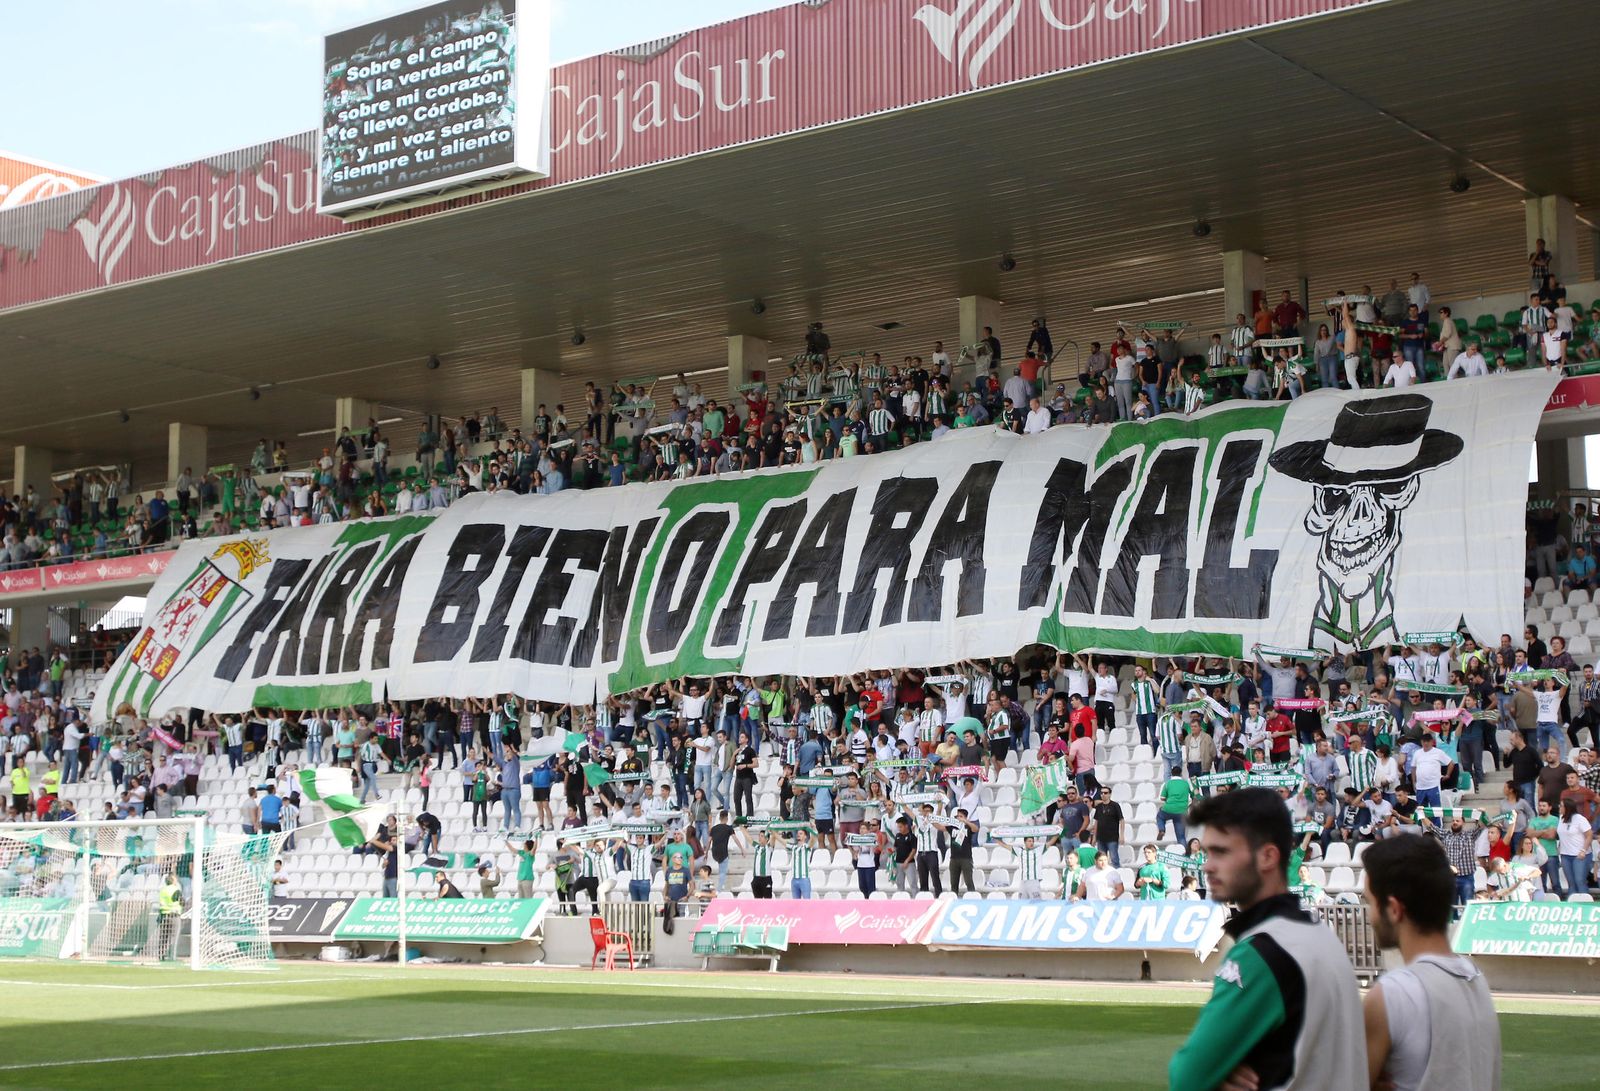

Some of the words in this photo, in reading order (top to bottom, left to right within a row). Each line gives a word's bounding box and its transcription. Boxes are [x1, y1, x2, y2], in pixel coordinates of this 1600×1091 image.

[347, 58, 402, 82] Sobre
[407, 47, 425, 65] el
[430, 31, 498, 58] campo
[376, 78, 393, 93] la
[398, 55, 466, 86] verdad
[338, 100, 391, 121] sobre
[396, 88, 420, 108] mi
[425, 69, 506, 99] corazón
[339, 127, 358, 141] te
[363, 115, 408, 135] llevo
[413, 91, 503, 121] Córdoba,
[333, 155, 410, 182] siempre
[415, 147, 435, 163] tu
[440, 130, 511, 157] aliento
[357, 146, 369, 162] y
[373, 136, 397, 155] mi
[402, 130, 436, 147] voz
[440, 114, 485, 137] será
[145, 160, 317, 256] CajaSu
[214, 532, 427, 682] PARA
[412, 516, 662, 669] BIEN
[711, 459, 1004, 648] PARA
[1018, 439, 1279, 620] MAL
[343, 924, 519, 936] www.corobacf.com/socios
[740, 914, 803, 928] CajaSur
[859, 915, 917, 932] CajaSu
[942, 904, 1212, 944] SAMSUNG
[1504, 902, 1582, 922] CÓRDOBA
[1530, 923, 1598, 936] COMPLETA
